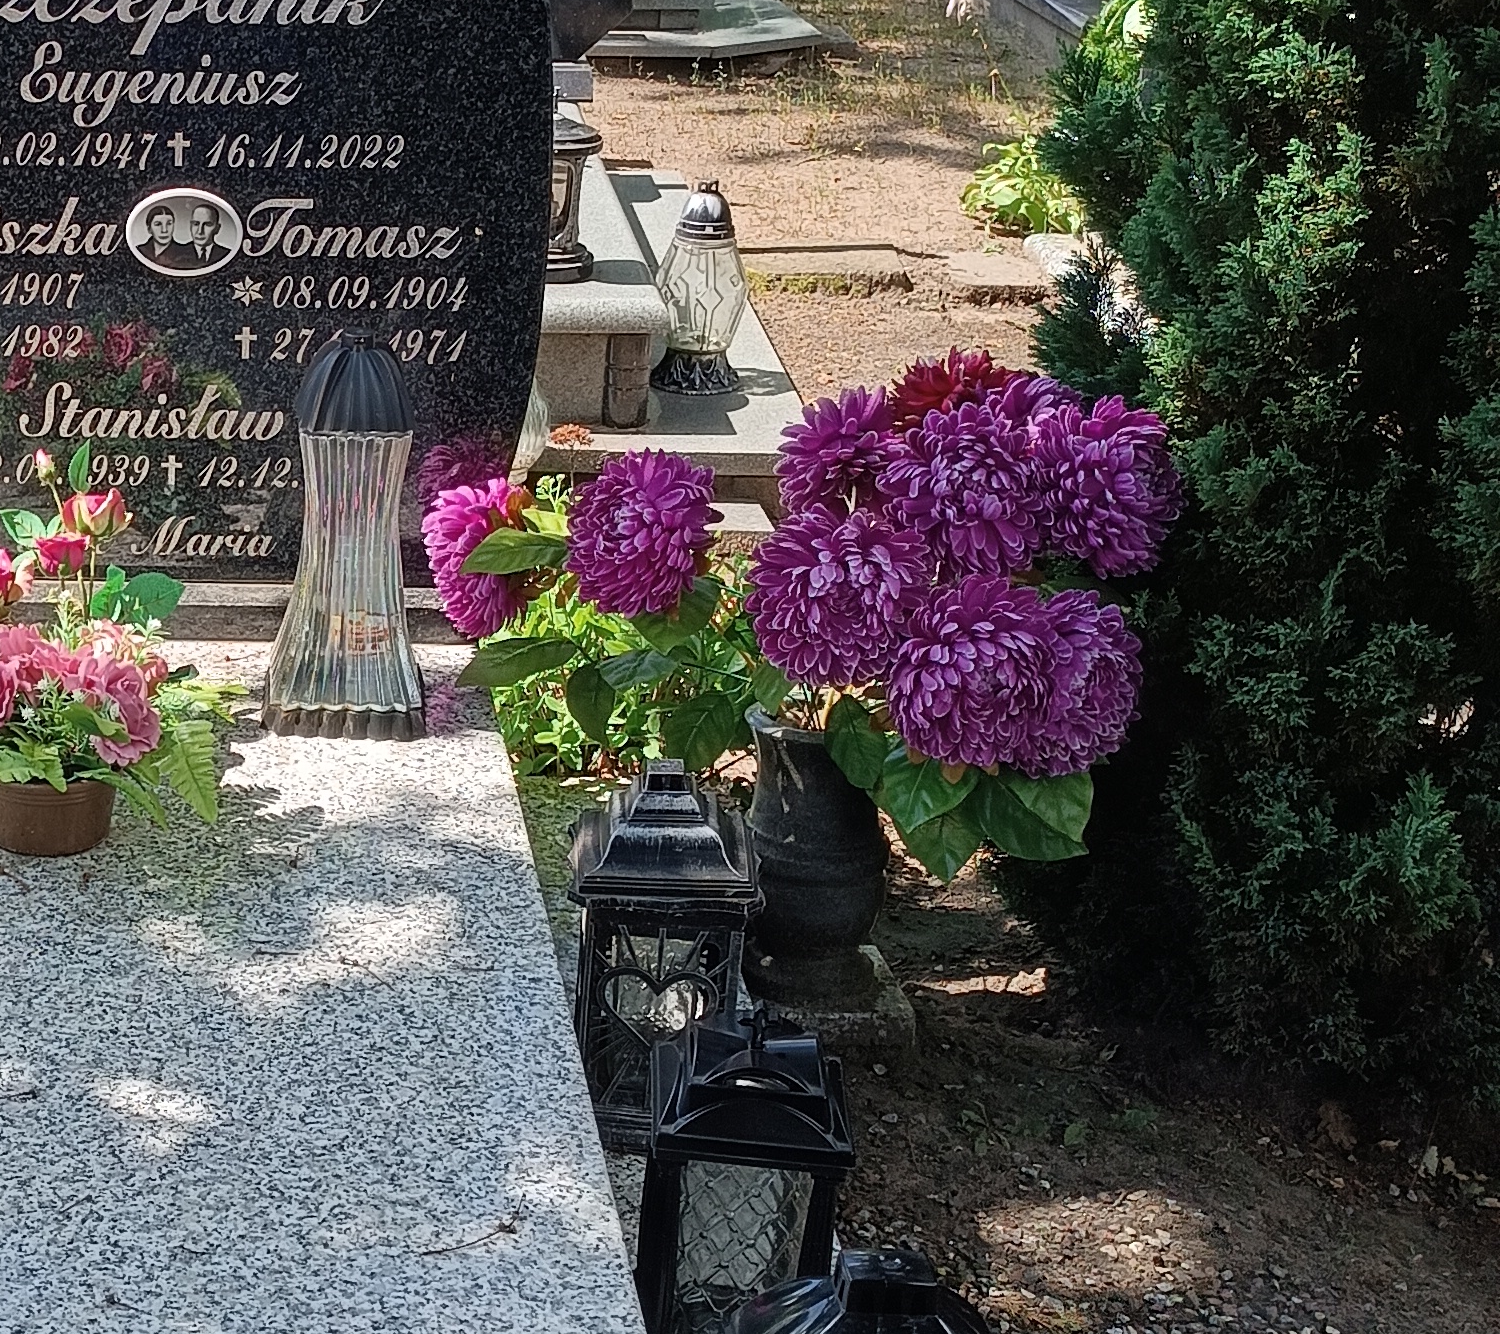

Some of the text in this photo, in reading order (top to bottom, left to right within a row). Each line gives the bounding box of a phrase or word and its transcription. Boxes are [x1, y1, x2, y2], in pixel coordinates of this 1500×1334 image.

[19, 40, 302, 128] Eugeniusz
[205, 133, 406, 170] 16.11.2022
[242, 198, 463, 259] Tomasz
[272, 275, 469, 312] 08.09.1904
[18, 381, 284, 441] Stanisław
[130, 515, 278, 558] Maria
